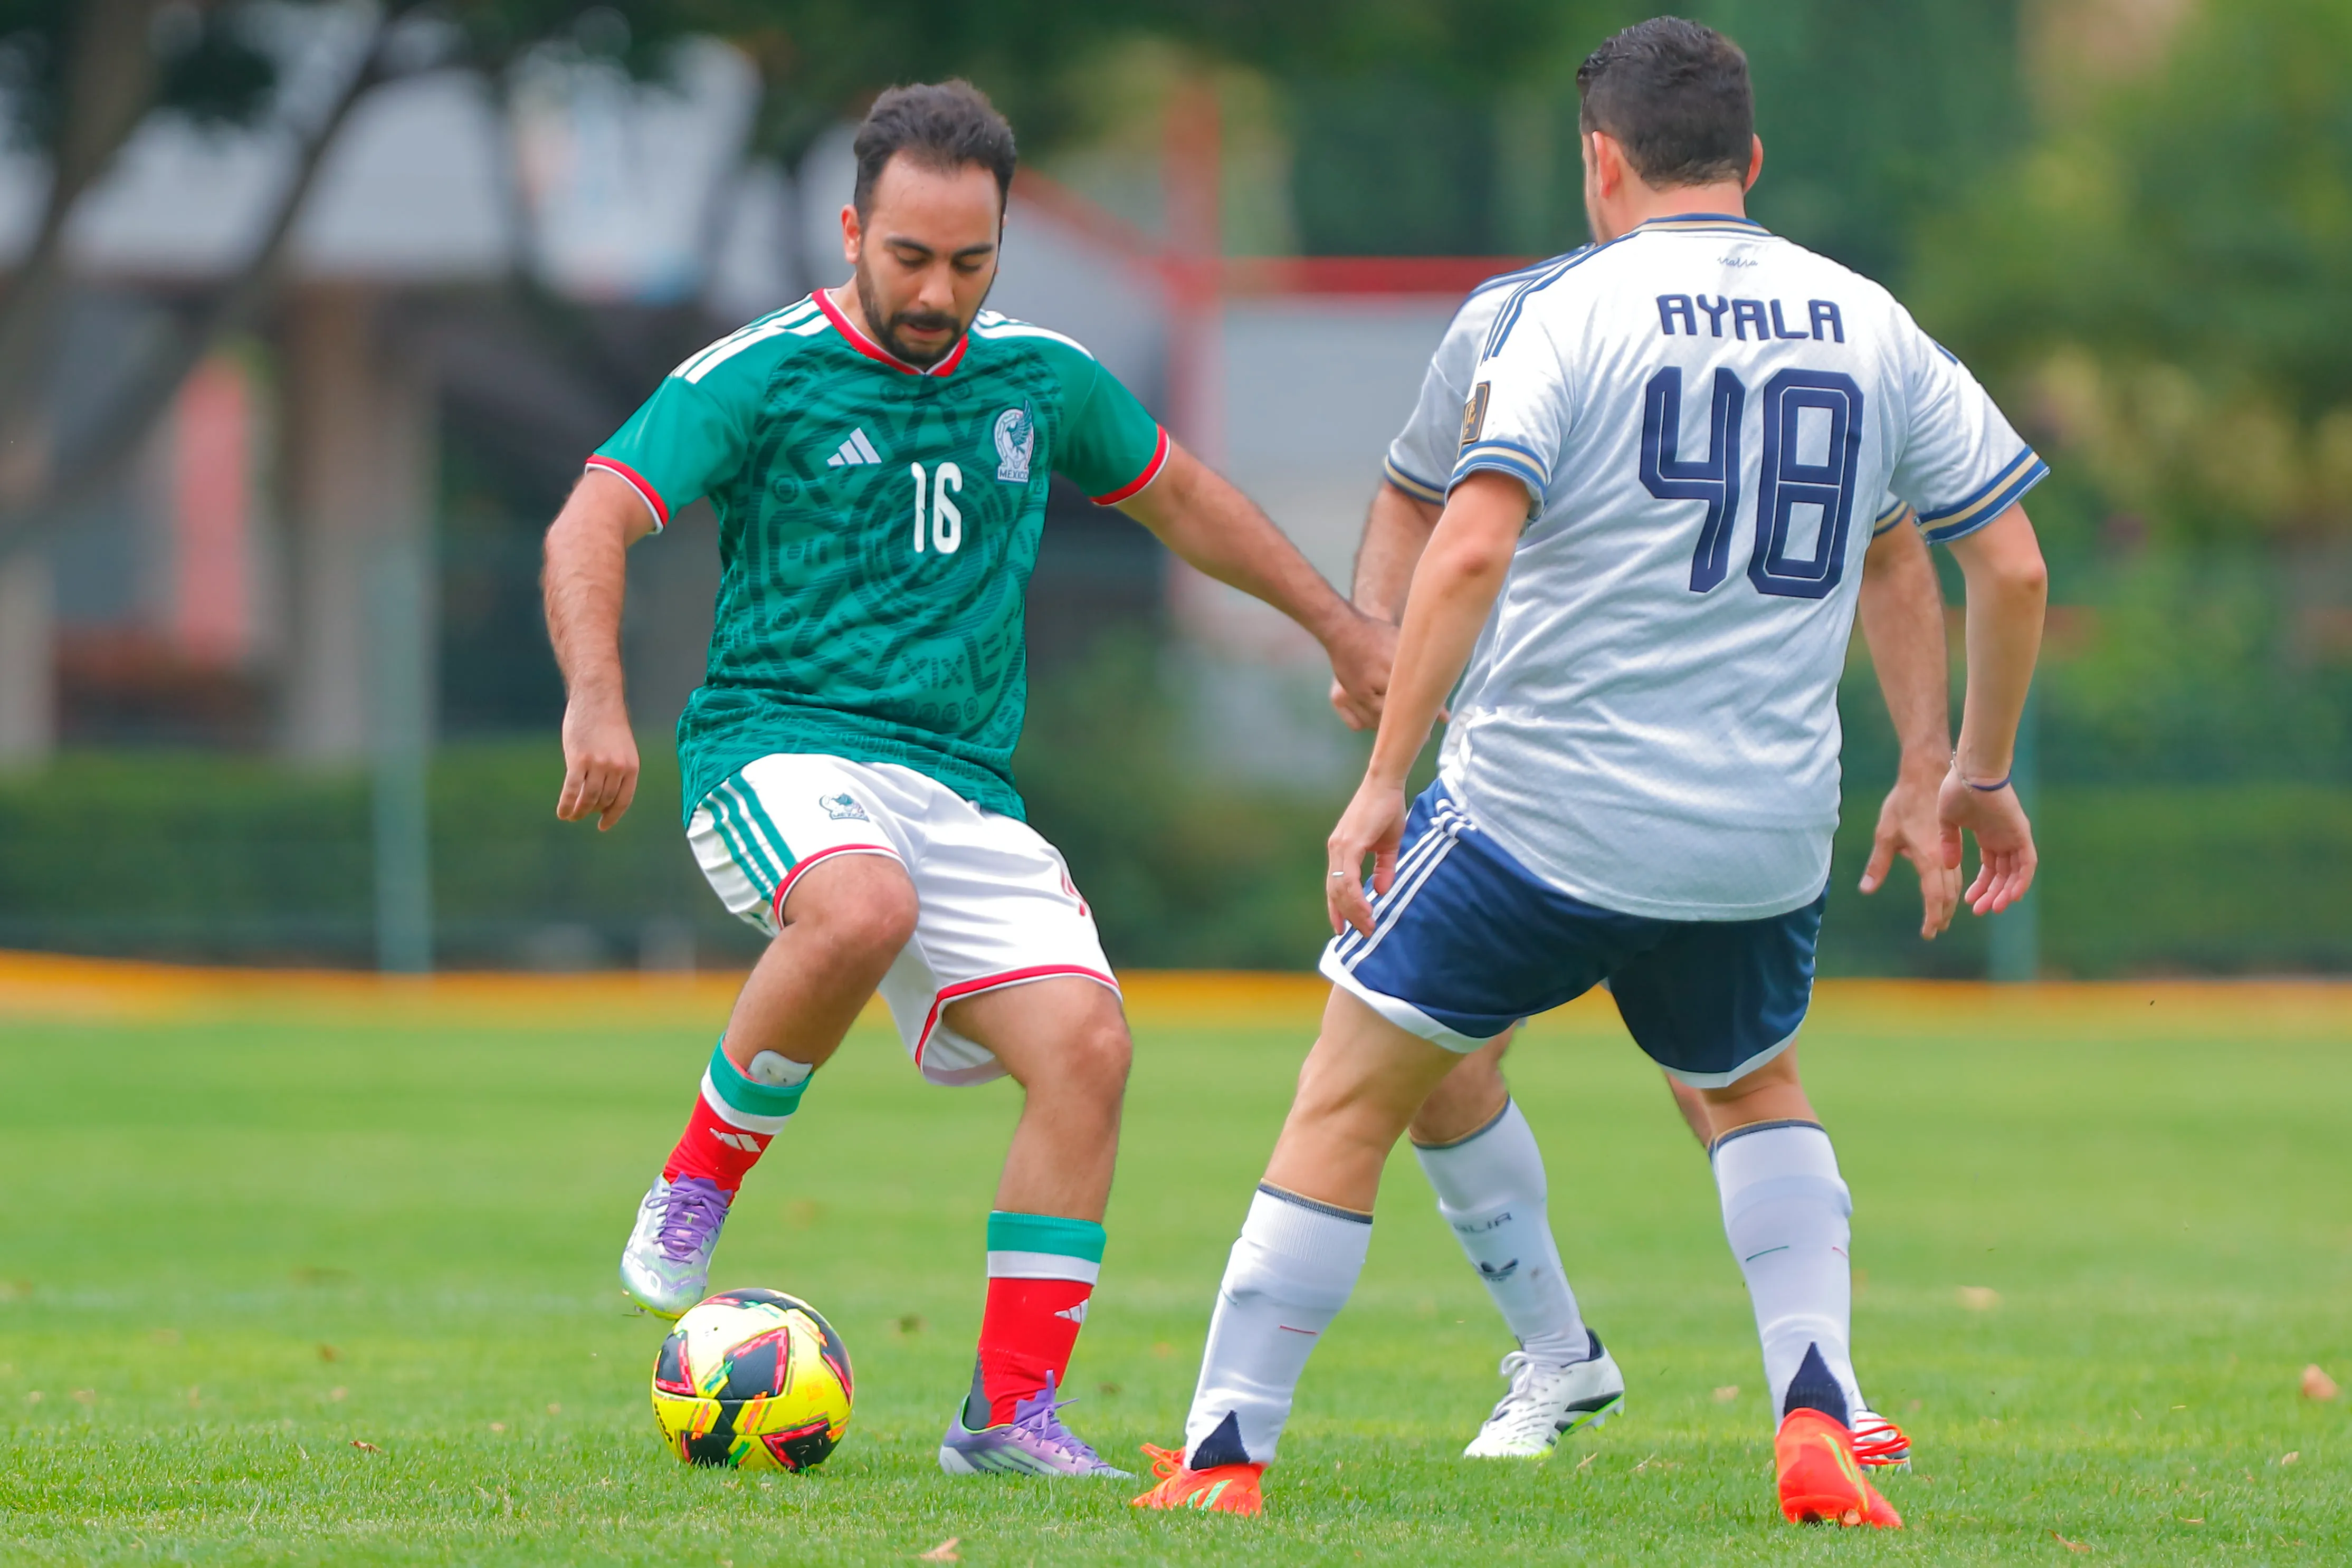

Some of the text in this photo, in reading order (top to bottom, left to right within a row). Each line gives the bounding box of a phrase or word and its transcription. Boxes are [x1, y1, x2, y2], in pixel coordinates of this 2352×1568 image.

[1656, 294, 1845, 343] AYALA
[911, 461, 963, 553] 16
[999, 467, 1029, 480] MEXICO
[1639, 366, 1864, 599] 48
